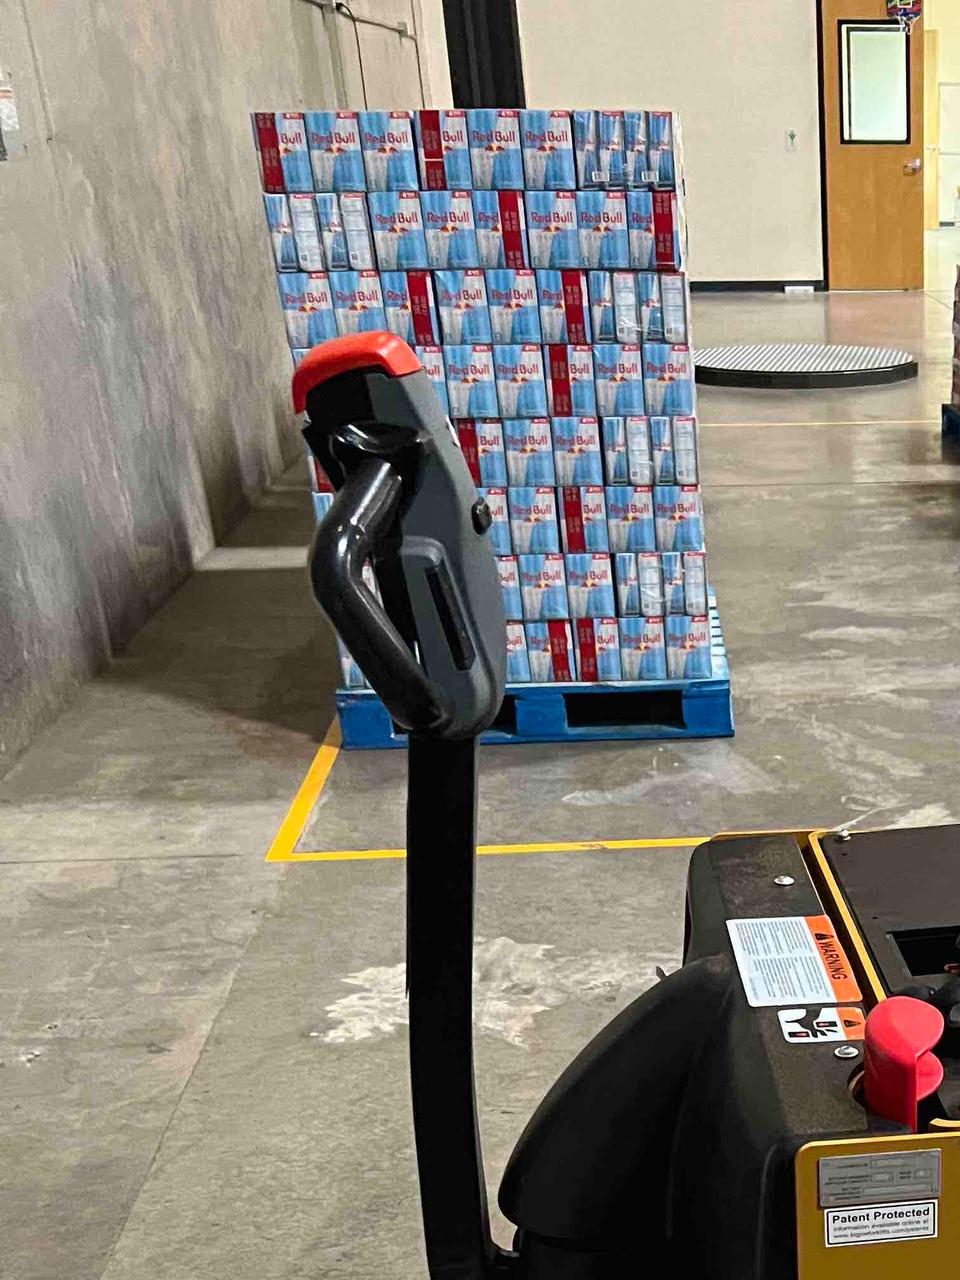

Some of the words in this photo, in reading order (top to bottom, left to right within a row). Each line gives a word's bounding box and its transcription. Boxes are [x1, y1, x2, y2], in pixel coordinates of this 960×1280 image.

[820, 940, 848, 980] WARNING
[832, 1213, 870, 1224] Patent
[873, 1207, 930, 1220] Protected
